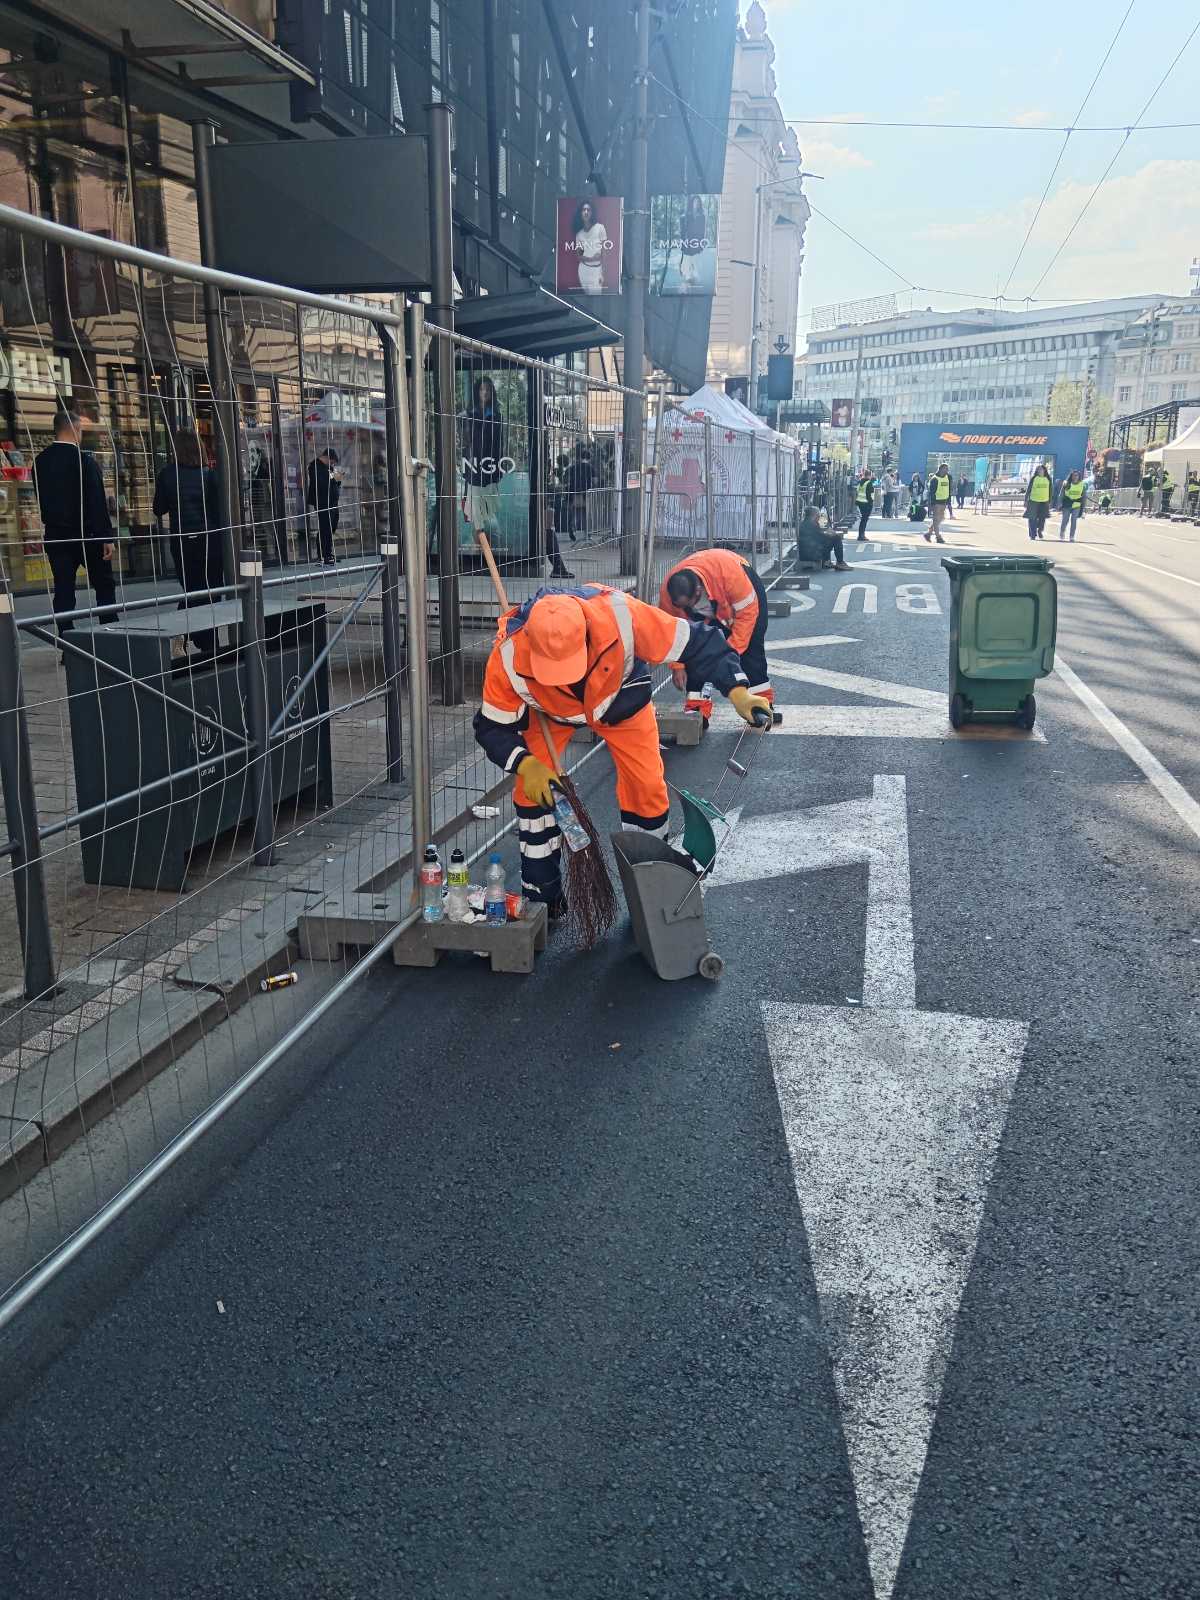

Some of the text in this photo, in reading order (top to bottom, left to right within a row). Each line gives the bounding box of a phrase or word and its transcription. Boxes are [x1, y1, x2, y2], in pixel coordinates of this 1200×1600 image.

[565, 240, 614, 250] MANGO
[659, 239, 710, 249] MANGO
[331, 392, 371, 423] DELFI
[962, 434, 1048, 445] ПОШТА СРБИЈЕ
